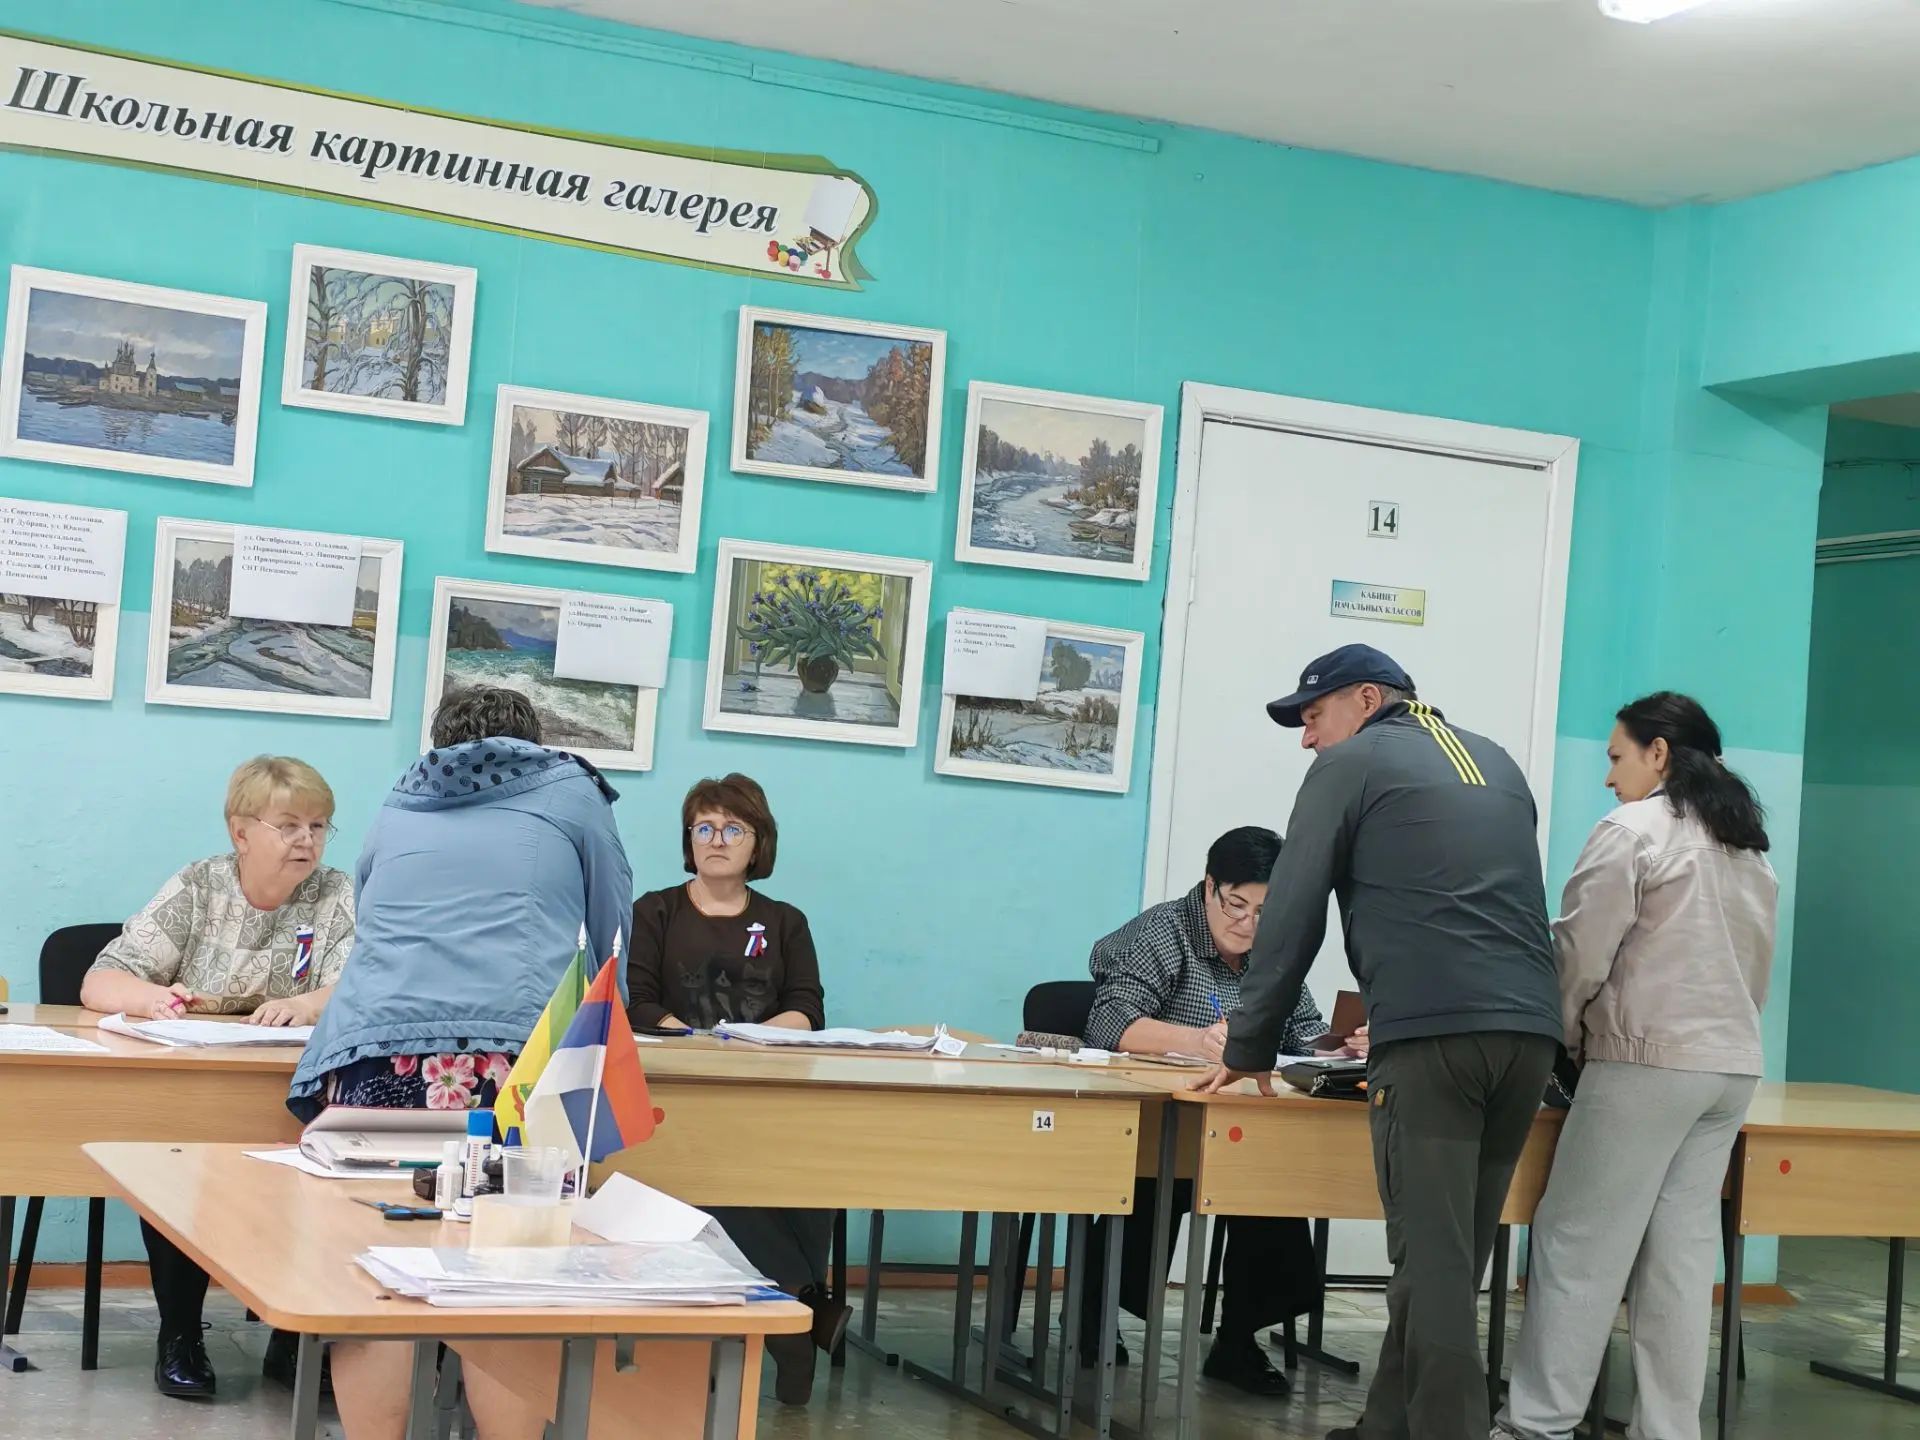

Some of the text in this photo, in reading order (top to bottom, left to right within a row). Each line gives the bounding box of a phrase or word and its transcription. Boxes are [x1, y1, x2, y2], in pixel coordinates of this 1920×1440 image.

[5, 66, 780, 235] Школьная картинная галерея
[1371, 506, 1396, 533] 14
[1361, 590, 1398, 602] КАБИНЕТ
[1334, 601, 1422, 618] НАЧАЛЬНЫХ КЛАССОВ
[1036, 1116, 1052, 1129] 14
